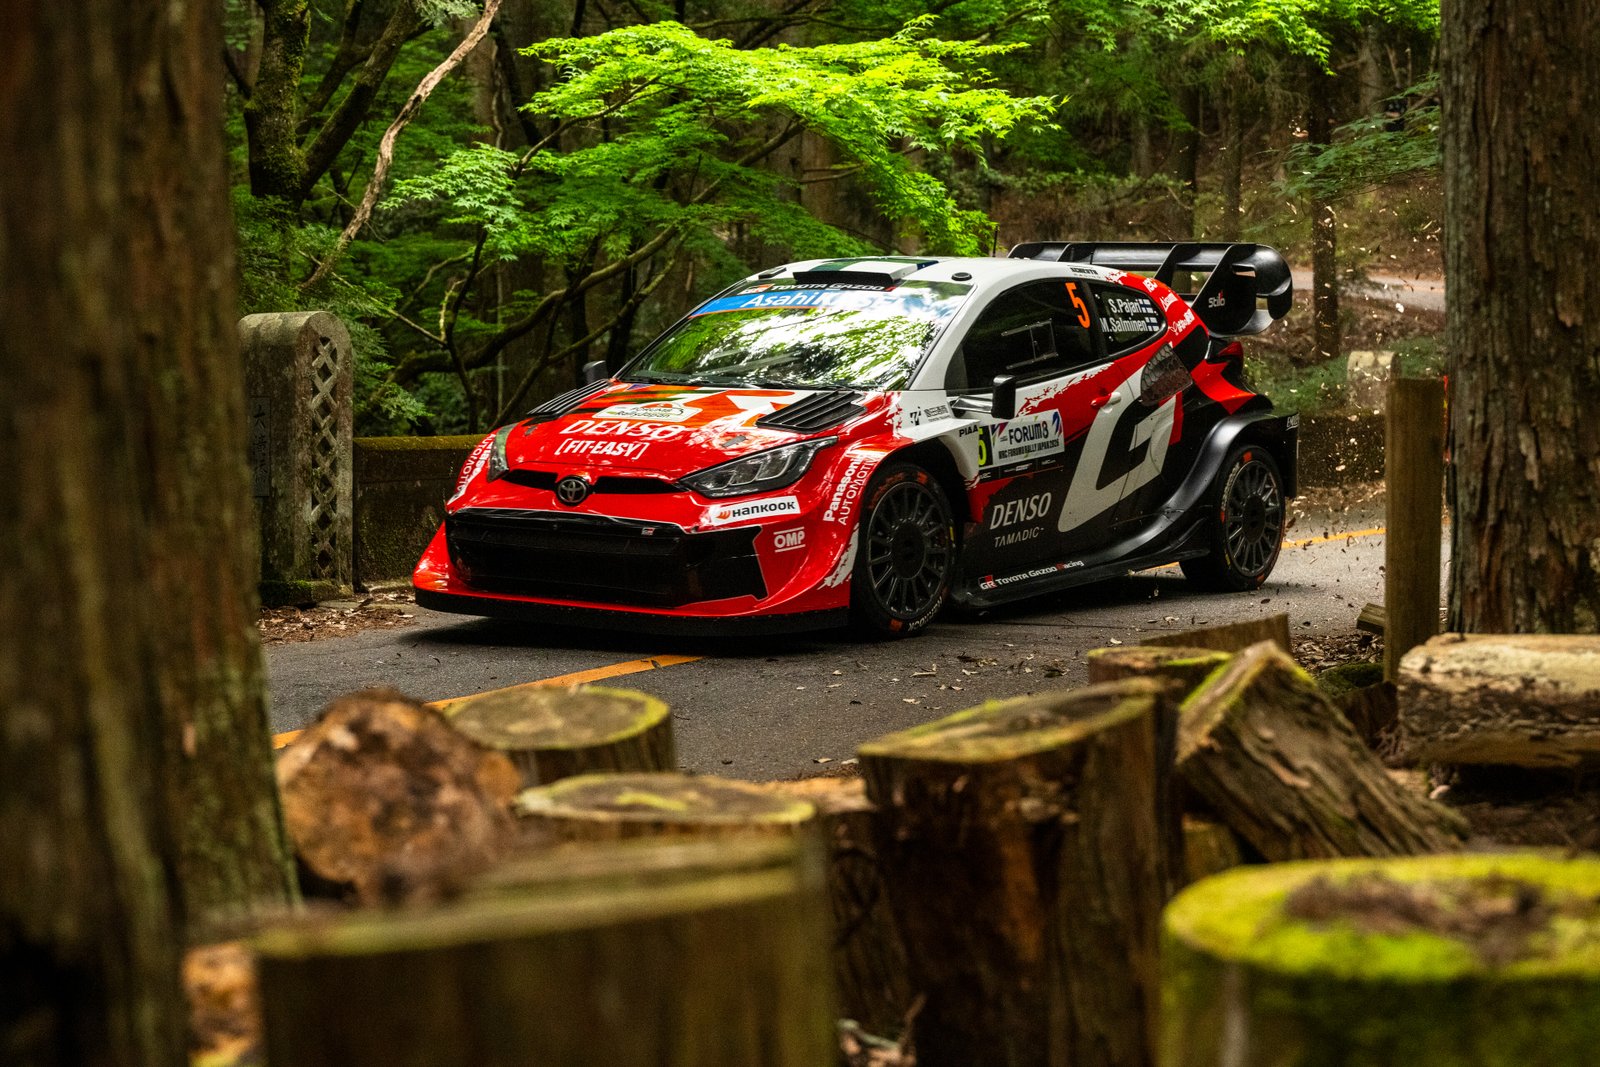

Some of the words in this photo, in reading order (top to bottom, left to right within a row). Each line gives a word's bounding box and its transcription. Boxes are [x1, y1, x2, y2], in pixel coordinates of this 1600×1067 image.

[771, 283, 828, 291] TOYOTA
[829, 282, 885, 291] GAZOO
[1065, 282, 1091, 329] 5
[1108, 298, 1141, 316] S.Pajari
[1100, 316, 1148, 332] M.Salminen
[559, 420, 686, 439] DENSO
[959, 424, 978, 438] PIAA
[1008, 421, 1049, 445] FORUM8
[989, 492, 1052, 530] DENSO
[774, 530, 805, 549] OMP
[994, 526, 1040, 548] TAMADIC
[995, 573, 1028, 586] TOYOTA
[1028, 566, 1058, 578] GAZOO
[1057, 560, 1085, 571] Racing
